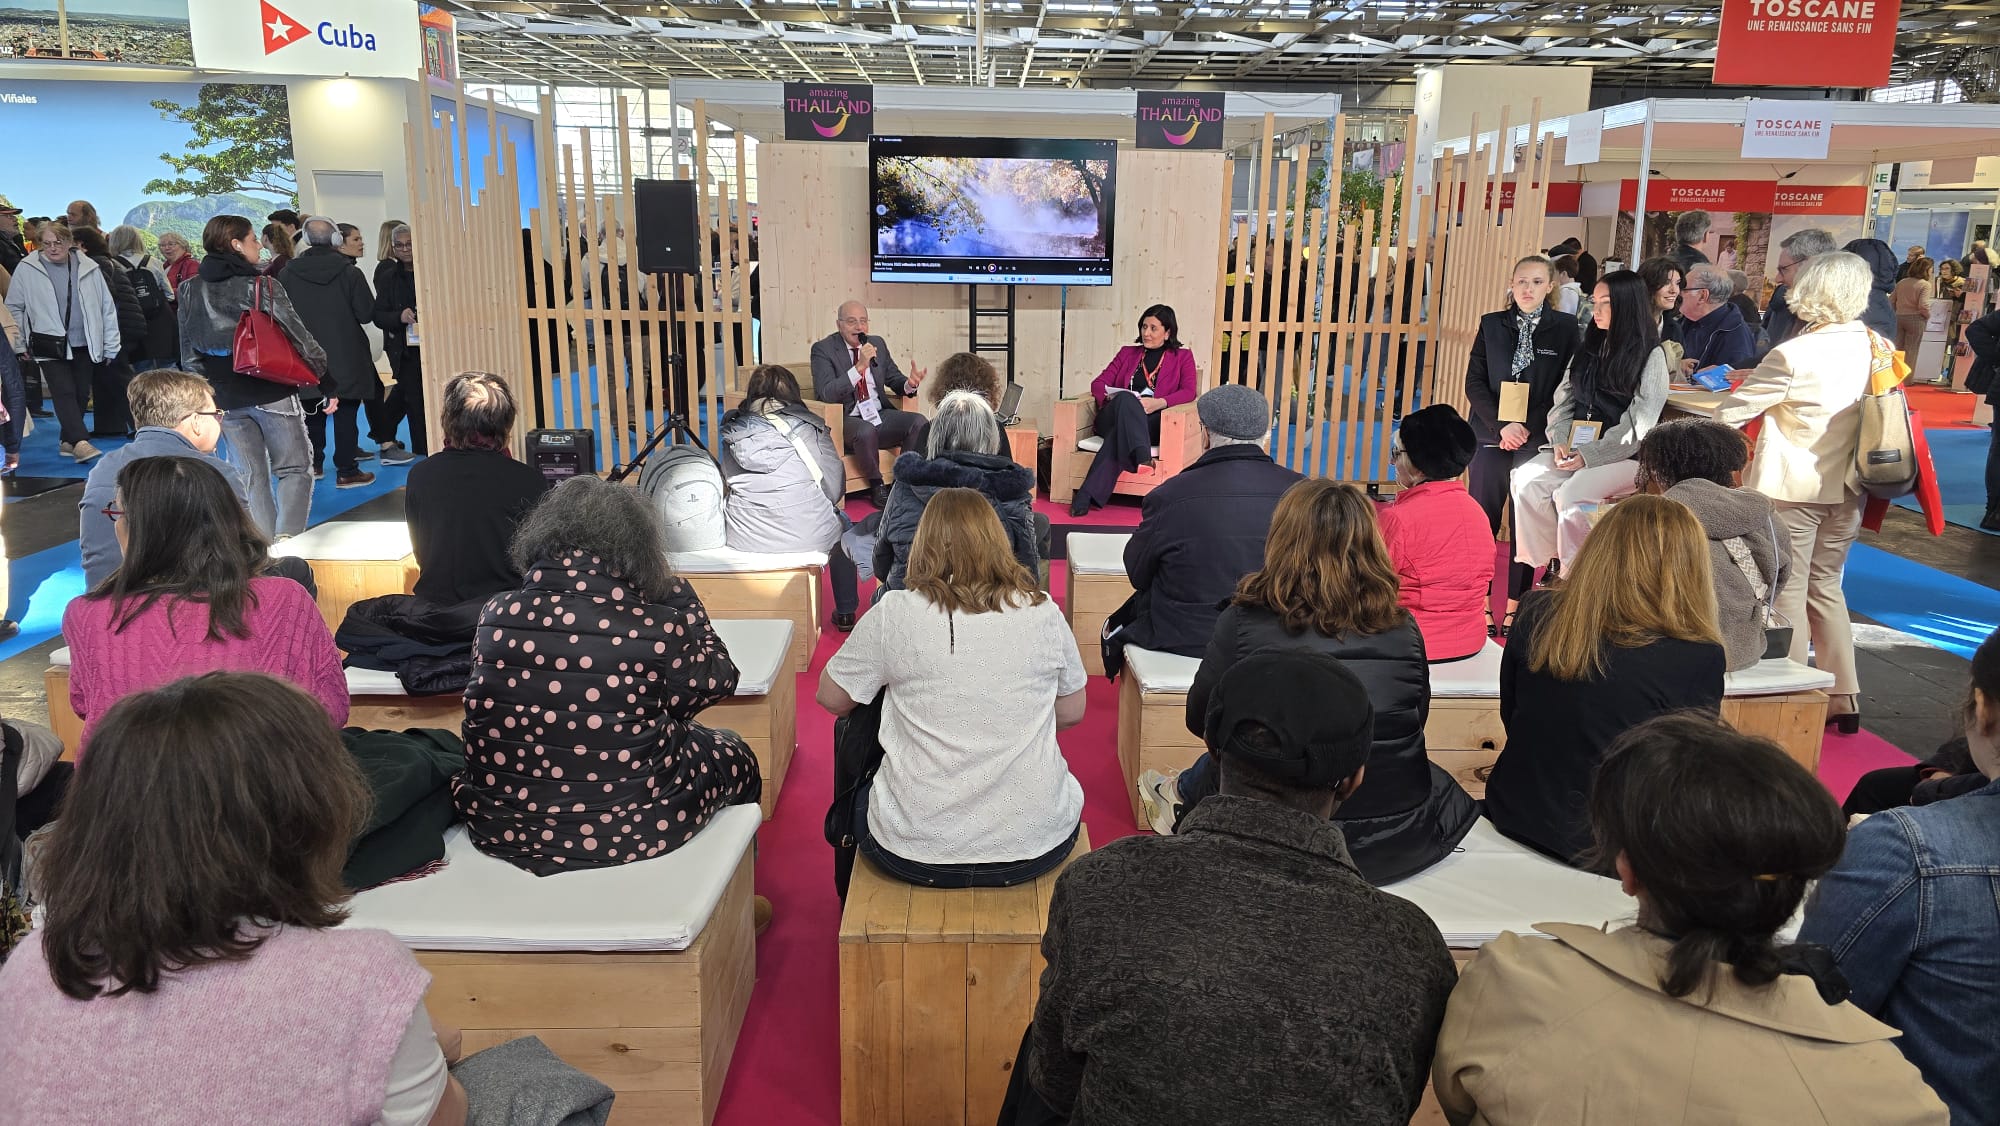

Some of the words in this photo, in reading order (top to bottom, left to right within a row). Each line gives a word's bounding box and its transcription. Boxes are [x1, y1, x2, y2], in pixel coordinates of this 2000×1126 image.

[1750, 0, 1875, 19] TOSCANE
[1747, 20, 1765, 31] UNE
[1768, 20, 1828, 33] RENAISSANCE
[1831, 22, 1854, 33] SANS
[1856, 23, 1872, 34] FIN
[317, 21, 377, 51] Cuba
[0, 46, 14, 54] uz
[0, 93, 38, 104] Viñales
[809, 88, 848, 100] amazing
[787, 98, 871, 114] THAILAND
[1162, 96, 1200, 107] amazing
[1140, 107, 1222, 122] THAILAND
[1756, 119, 1822, 130] TOSCANE
[1671, 188, 1726, 197] TOSCANE
[1775, 193, 1824, 201] TOSCANE
